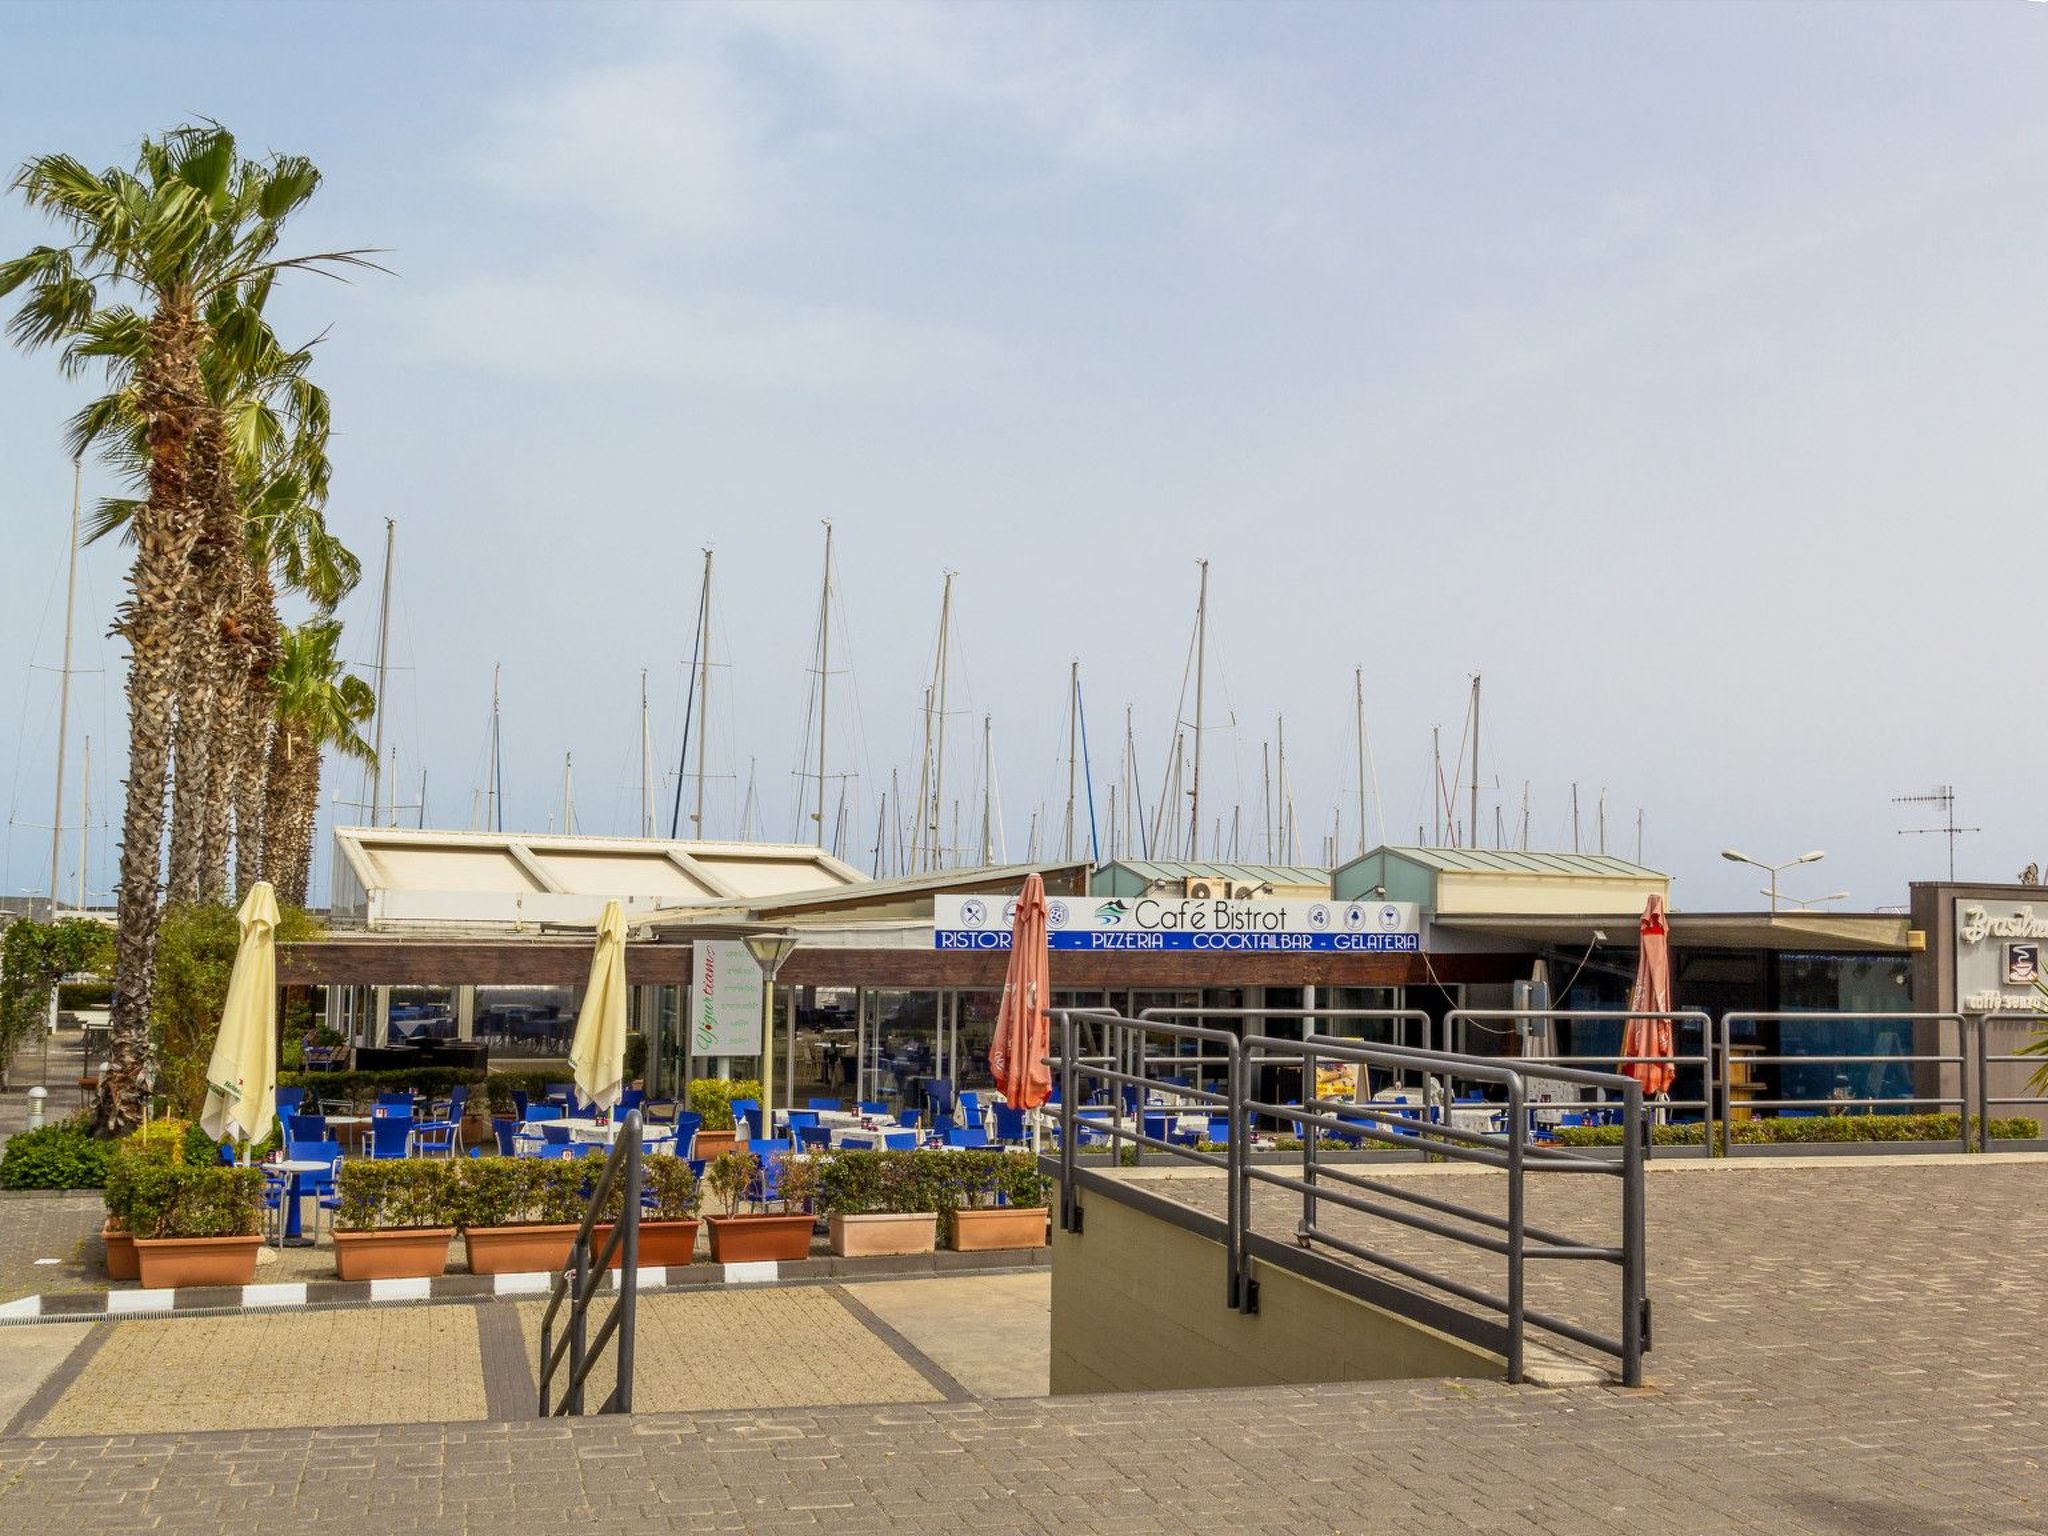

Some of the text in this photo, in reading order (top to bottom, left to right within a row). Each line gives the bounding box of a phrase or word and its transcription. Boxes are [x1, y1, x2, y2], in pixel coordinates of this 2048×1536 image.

[1135, 899, 1288, 931] Café Bistrot
[941, 931, 1056, 949] RISTORE
[1091, 932, 1164, 949] PIZZERIA
[1333, 934, 1418, 951] GELATERIA
